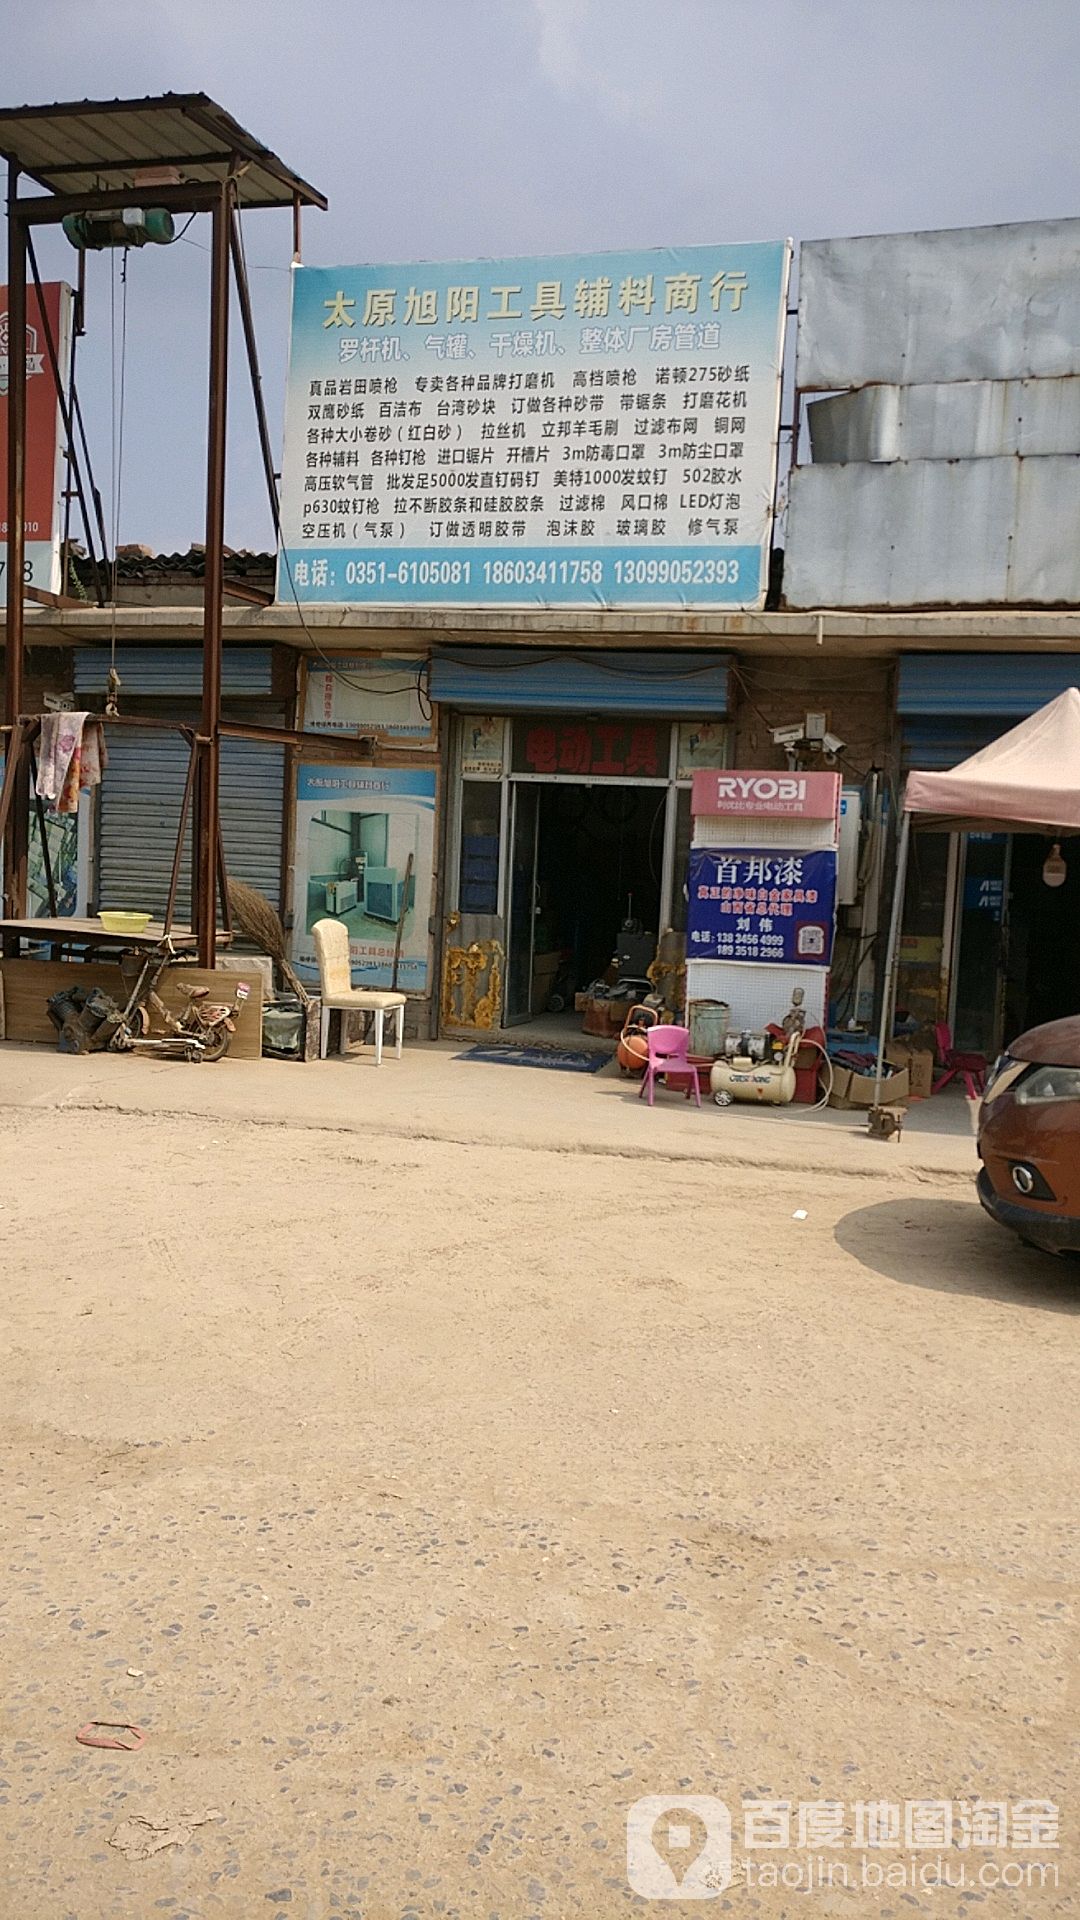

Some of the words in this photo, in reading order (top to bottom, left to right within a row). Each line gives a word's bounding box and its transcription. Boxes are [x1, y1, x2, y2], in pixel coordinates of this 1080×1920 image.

[322, 271, 749, 329] 太原旭阳工具辅料商行
[309, 376, 398, 397] 真品岩田喷枪
[414, 371, 555, 393] 专卖各种品牌打磨机
[572, 368, 637, 388] 高档喷枪
[655, 365, 750, 385] 诺顿275砂纸
[307, 402, 365, 420] 双鹰砂纸
[379, 400, 422, 418] 百洁布
[437, 399, 496, 417] 台湾砂块
[511, 394, 604, 414] 订做各种砂带
[620, 392, 667, 411] 带锯条
[683, 390, 748, 410] 打磨花机
[481, 422, 526, 440] 拉丝机
[541, 418, 619, 438] 立邦羊毛刷
[634, 417, 698, 436] 过滤布网
[714, 416, 746, 435] 铜网
[305, 450, 360, 469] 各种辅料
[371, 449, 426, 468] 各种钉枪
[437, 448, 495, 466] 进口锯片
[506, 446, 550, 464] 开槽片
[562, 443, 646, 463] 3m防毒口罩
[658, 441, 744, 460] 3m防尘口罩
[304, 473, 374, 493] 高压软气管
[553, 468, 667, 488] 美特1000发蚊钉
[682, 466, 743, 485] 502胶水
[393, 495, 544, 515] 拉不断胶条和硅胶胶条
[559, 494, 606, 512] 过滤棉
[620, 493, 668, 512] 风口棉
[679, 492, 741, 511] LED灯泡
[429, 520, 527, 538] 订做透明胶带
[546, 519, 596, 537] 泡沫胶
[616, 518, 667, 537] 玻璃胶
[687, 517, 739, 537] 修气泵
[345, 560, 471, 585] 0351-6105081
[483, 560, 603, 584] 18603411758
[614, 559, 739, 585] 13099052393
[526, 727, 660, 776] 电动工具
[717, 777, 806, 801] RYOBI
[714, 855, 803, 886] 首邦漆
